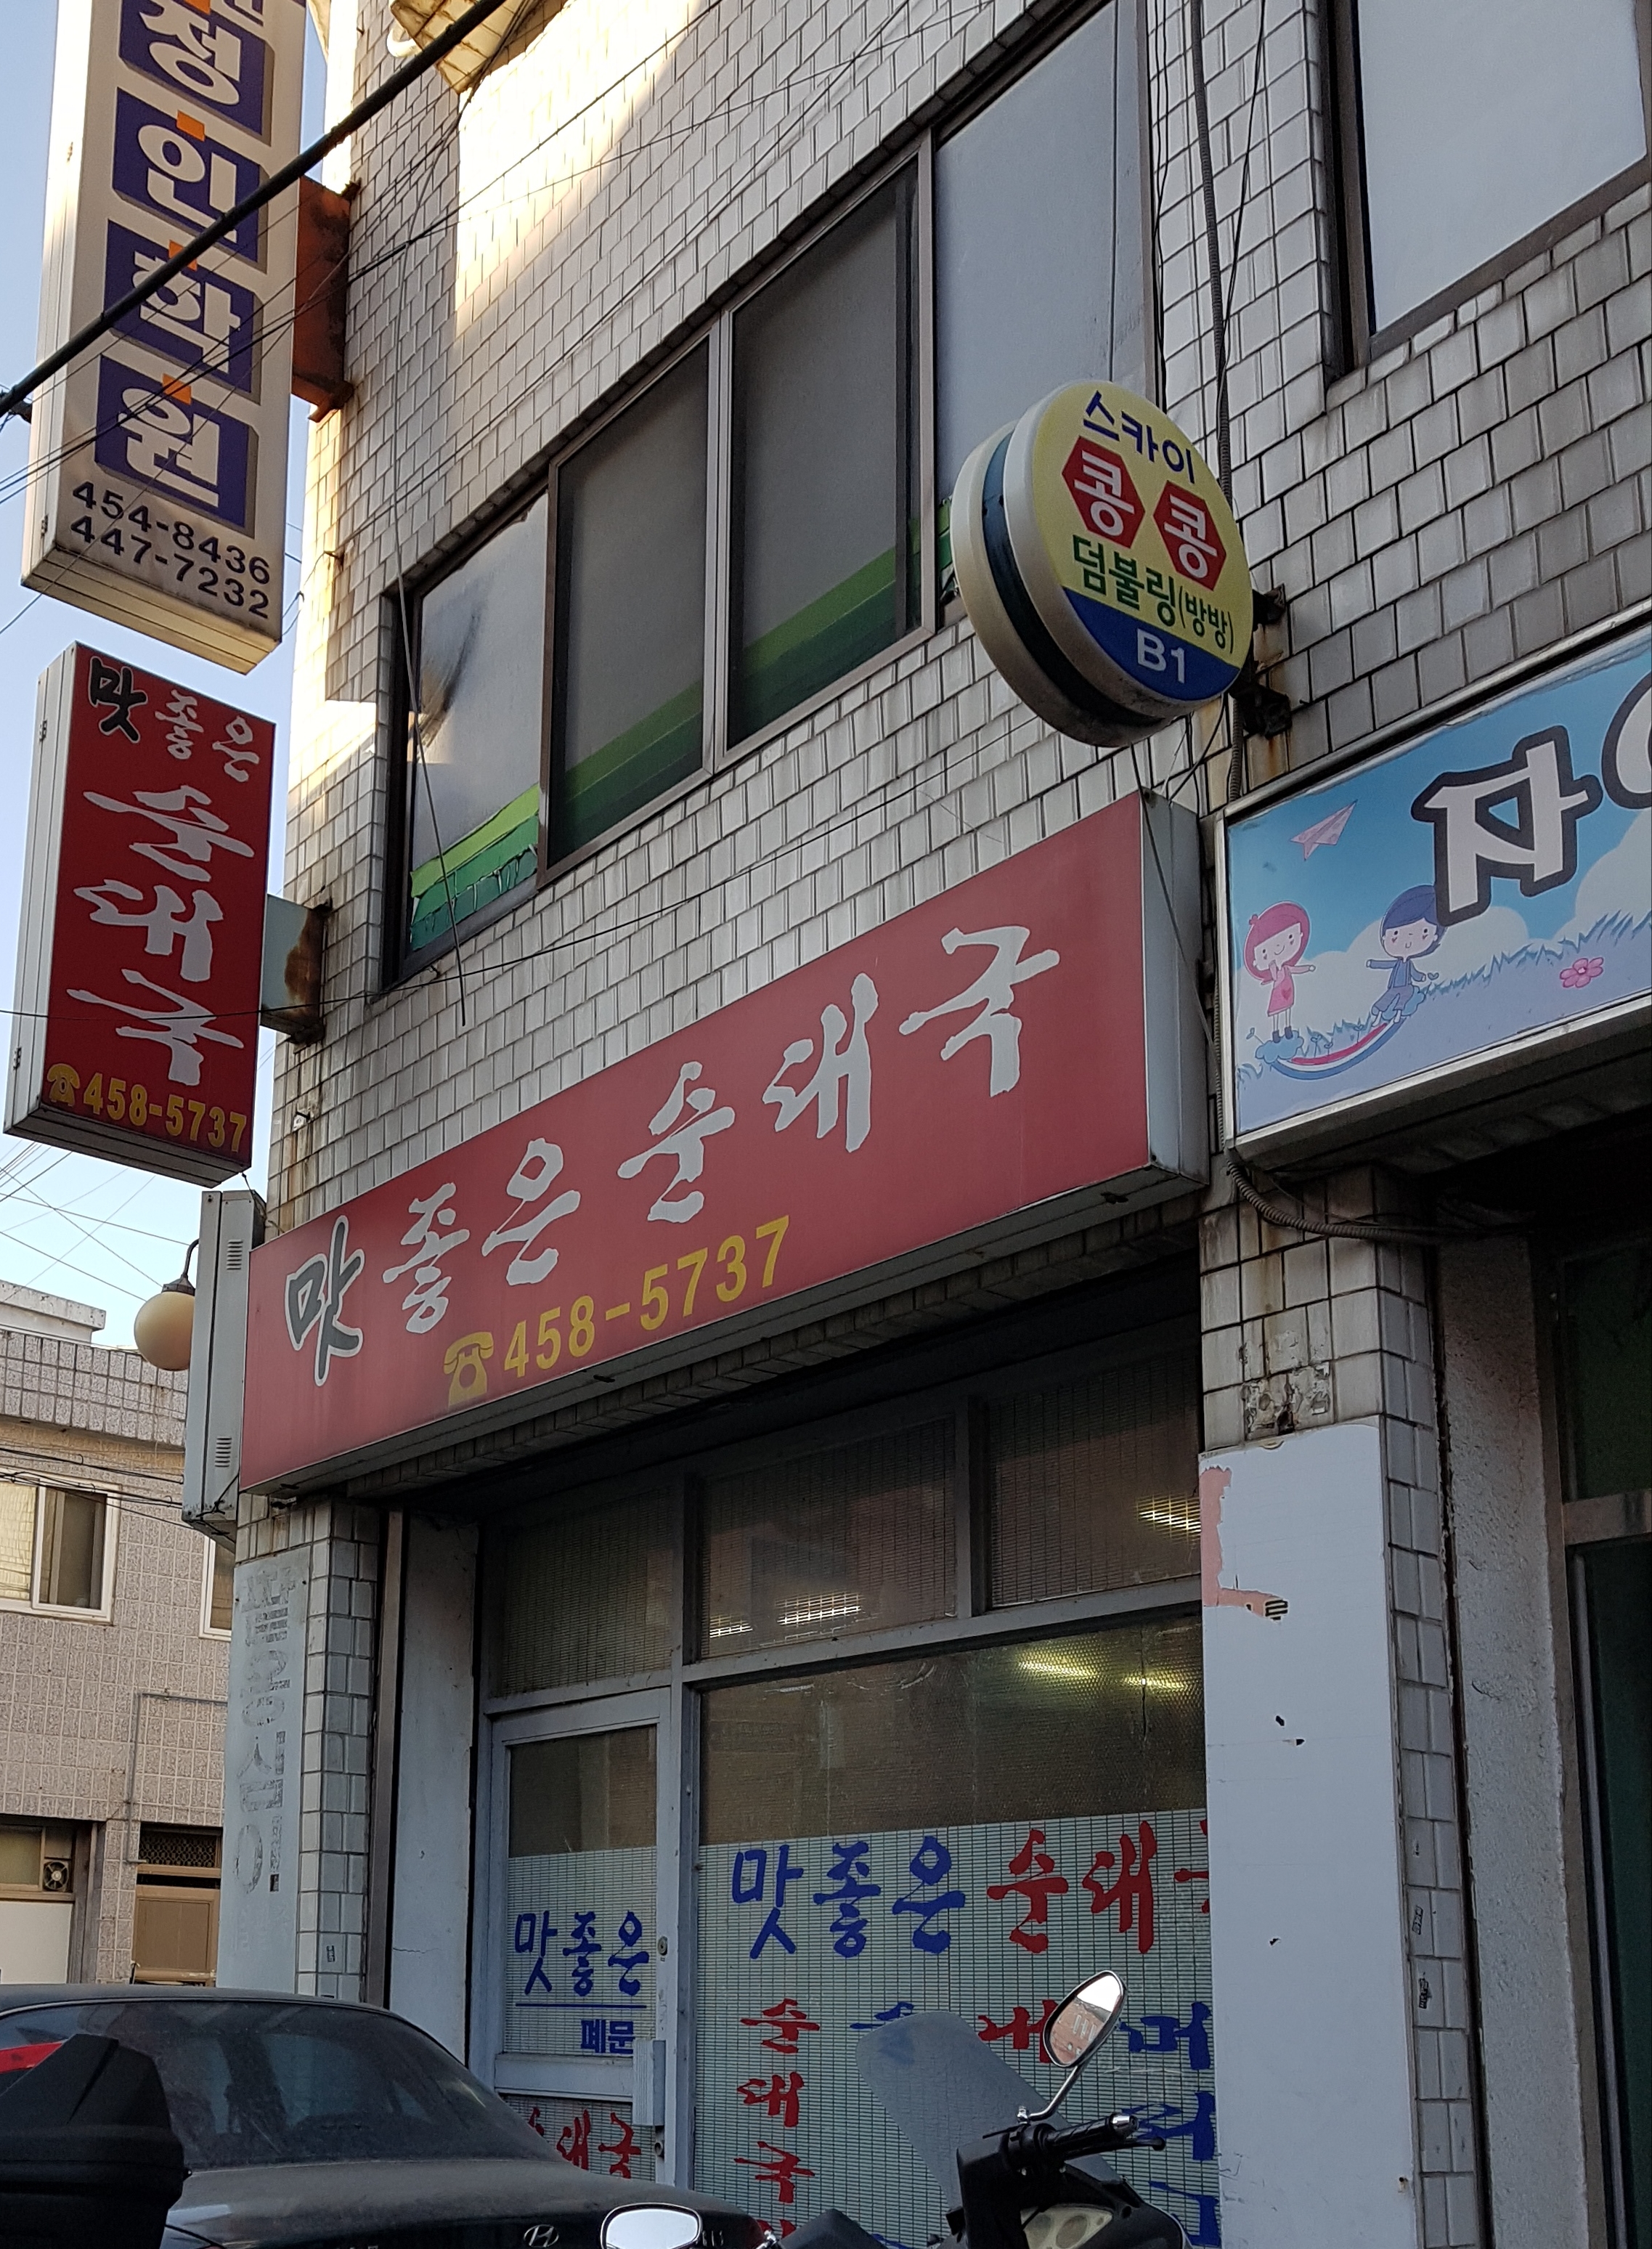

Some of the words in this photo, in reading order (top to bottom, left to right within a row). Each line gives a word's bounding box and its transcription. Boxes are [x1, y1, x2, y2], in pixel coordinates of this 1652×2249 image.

[118, 0, 264, 507] 정인학원
[1083, 390, 1195, 484] 스카이
[70, 515, 269, 619] 447-7232
[72, 481, 270, 585] 454-8436
[1074, 450, 1218, 579] 콩콩
[1137, 627, 1185, 683] B1
[89, 656, 260, 783] 맛좋은
[67, 785, 254, 1086] 순대국
[84, 1078, 248, 1152] 458-5737
[285, 1137, 580, 1387] 맛좋은
[617, 925, 1060, 1223] 순대국
[504, 1215, 790, 1378] 458-5737
[514, 1910, 649, 1996] 맛좋은
[732, 1835, 966, 1959] 맛좋은
[987, 1820, 1210, 1953] 순대
[735, 1998, 821, 2239] 순대국
